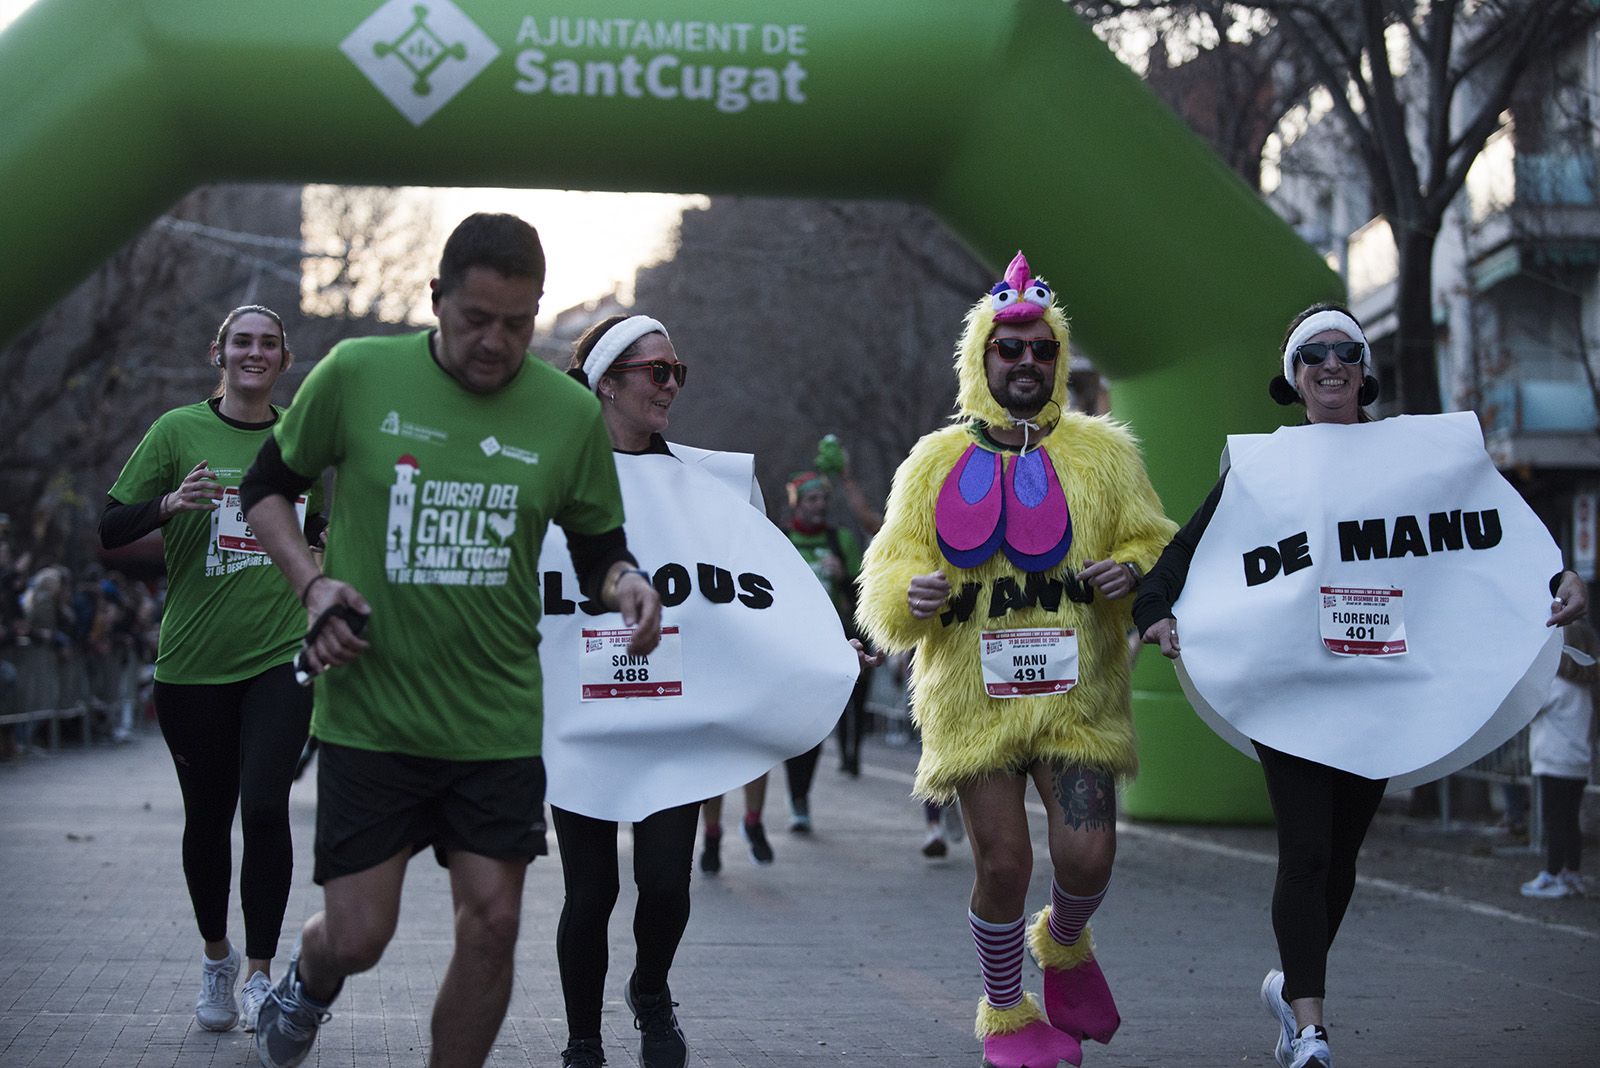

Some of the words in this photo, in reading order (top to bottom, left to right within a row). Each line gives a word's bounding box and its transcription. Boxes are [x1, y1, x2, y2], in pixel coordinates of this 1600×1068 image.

[516, 15, 754, 52] AJUNTAMENT
[762, 23, 808, 55] DE
[514, 49, 808, 113] SantCugat
[422, 480, 485, 508] CURSA
[486, 484, 519, 509] DEL
[417, 508, 490, 546] GALL
[1242, 531, 1313, 587] DE
[1337, 508, 1503, 562] MANU
[415, 545, 461, 569] SANT
[205, 567, 215, 577] 31
[215, 565, 226, 576] DE
[1332, 612, 1390, 625] FLORENCIA
[1345, 626, 1375, 640] 401
[612, 654, 649, 667] SONIA
[1013, 654, 1047, 667] MANU
[613, 668, 649, 682] 488
[1014, 667, 1045, 681] 491
